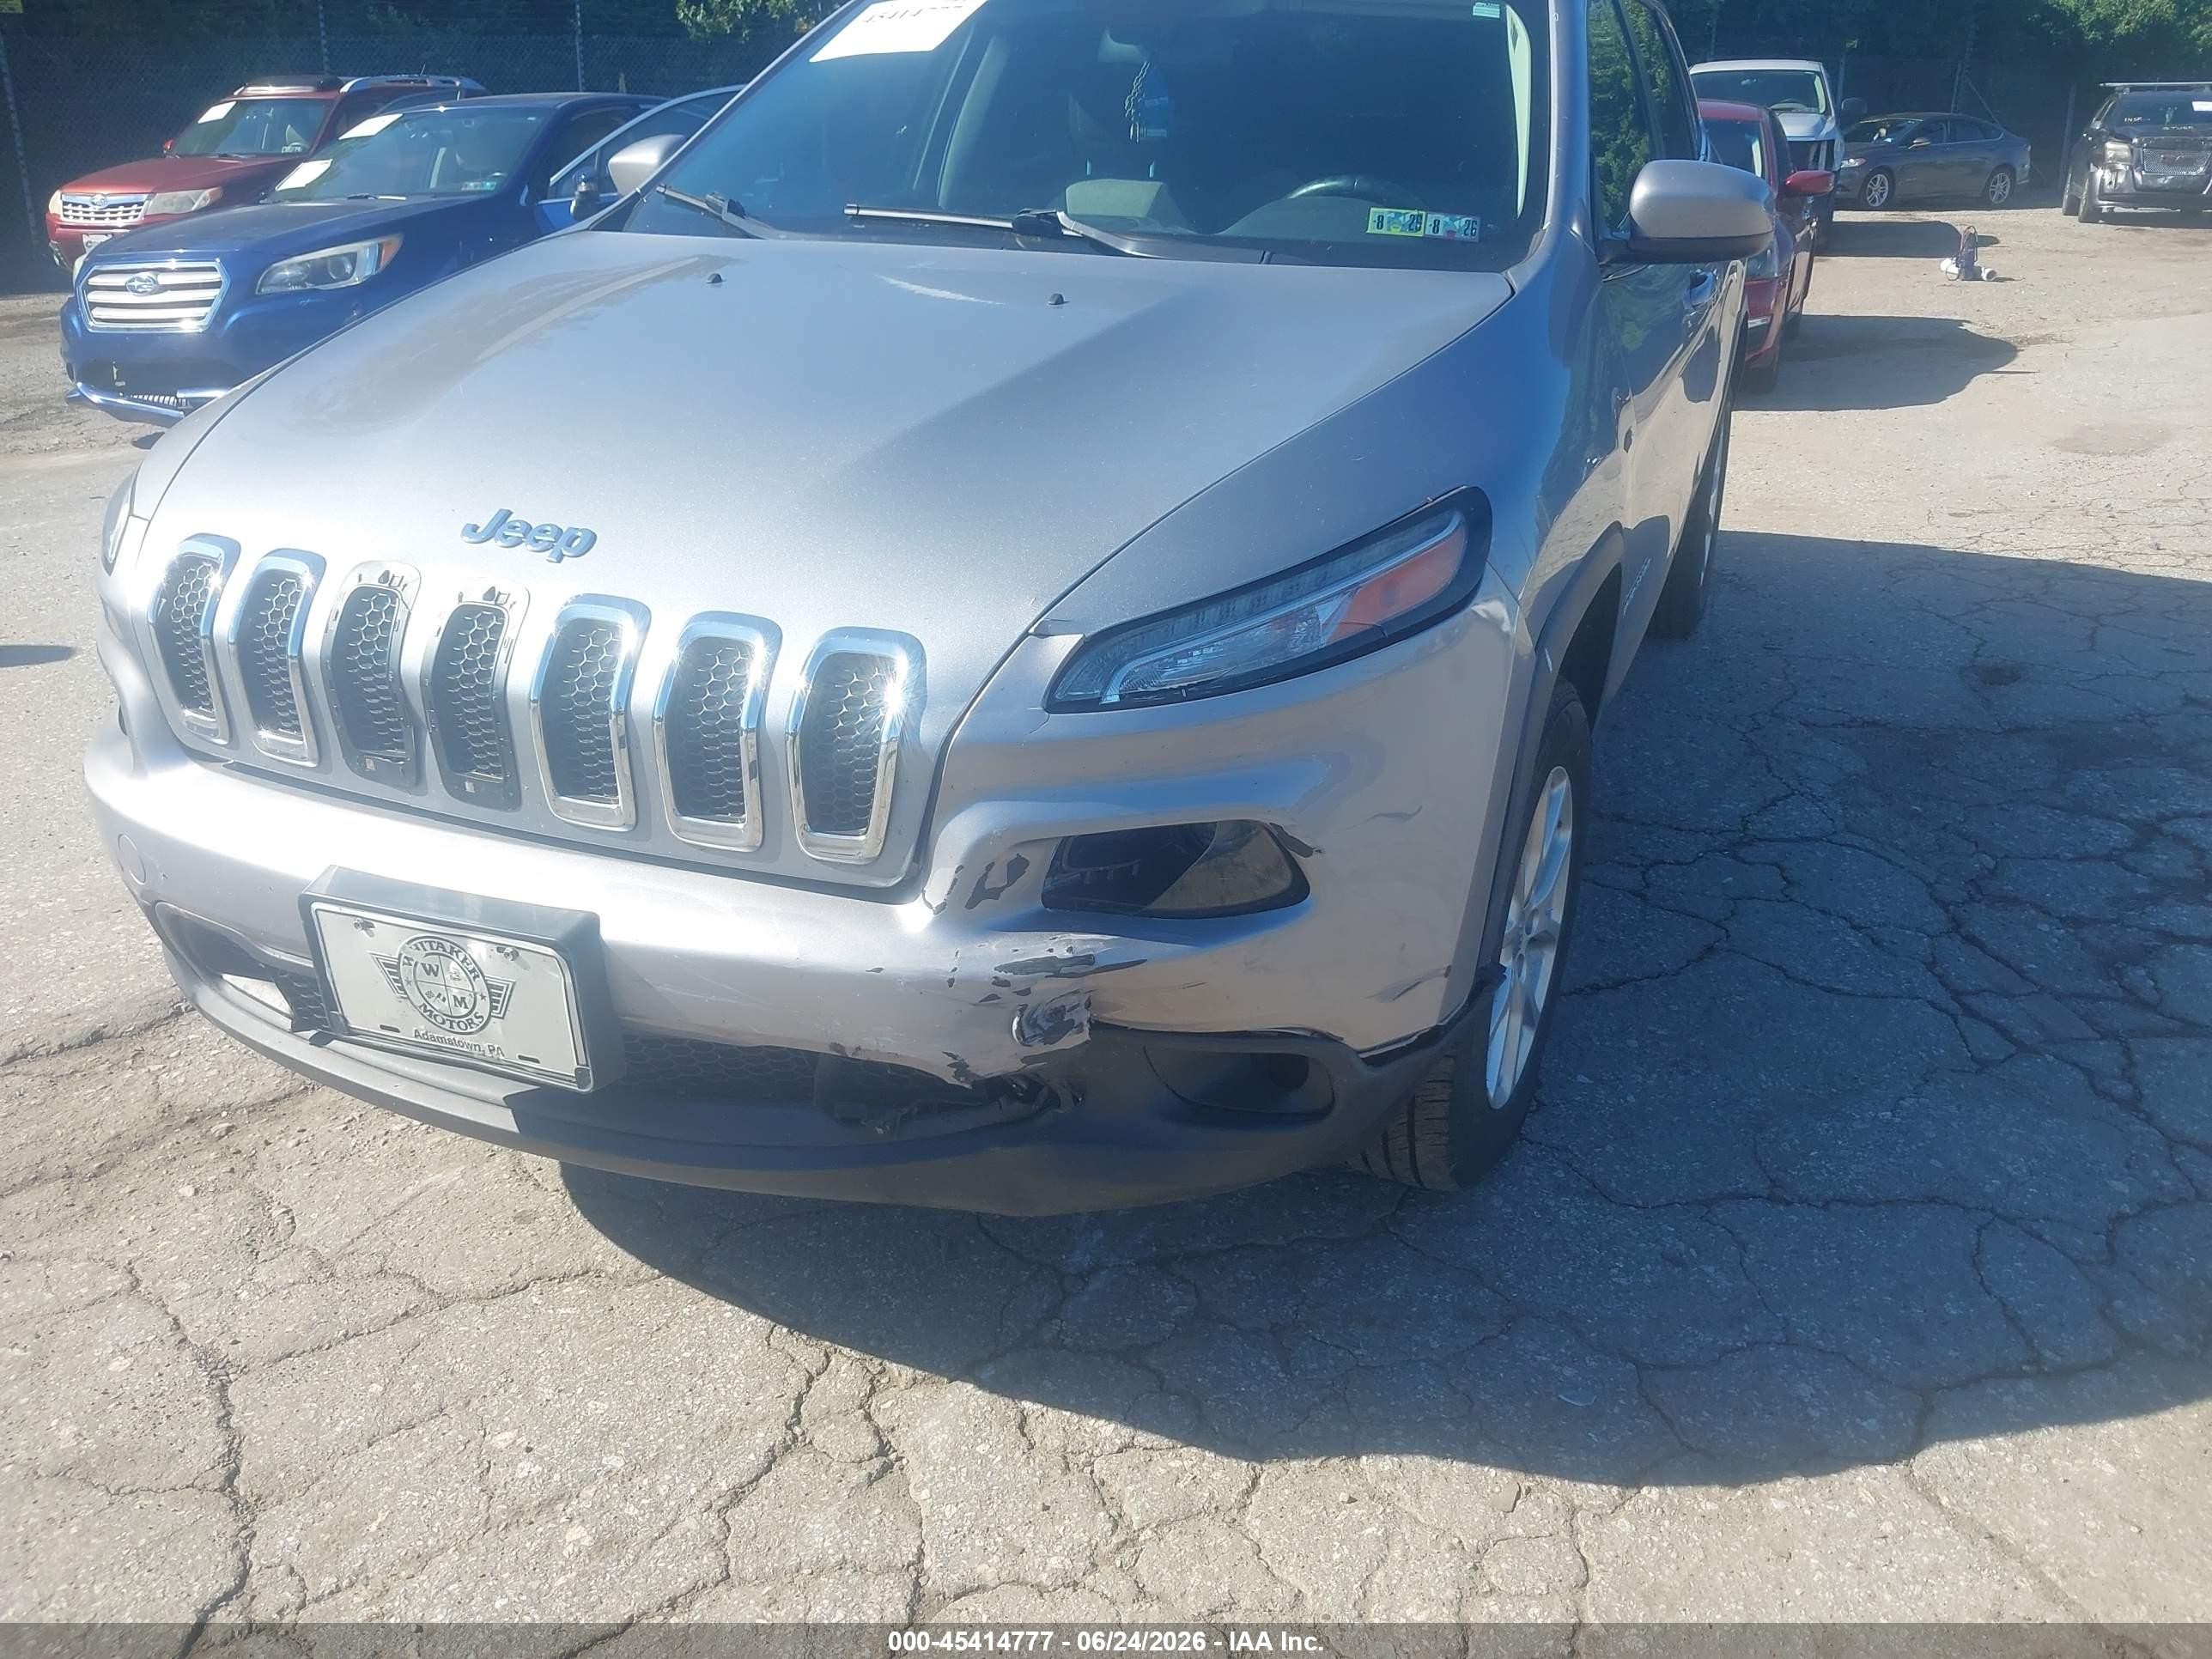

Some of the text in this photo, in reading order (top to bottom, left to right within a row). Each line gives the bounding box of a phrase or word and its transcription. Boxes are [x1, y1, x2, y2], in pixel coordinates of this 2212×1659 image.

[1463, 220, 1478, 237] 26
[460, 508, 598, 563] Jeep
[420, 962, 440, 977] W
[453, 994, 470, 1010] M
[418, 1002, 485, 1031] MOTORS
[487, 1044, 506, 1058] PA
